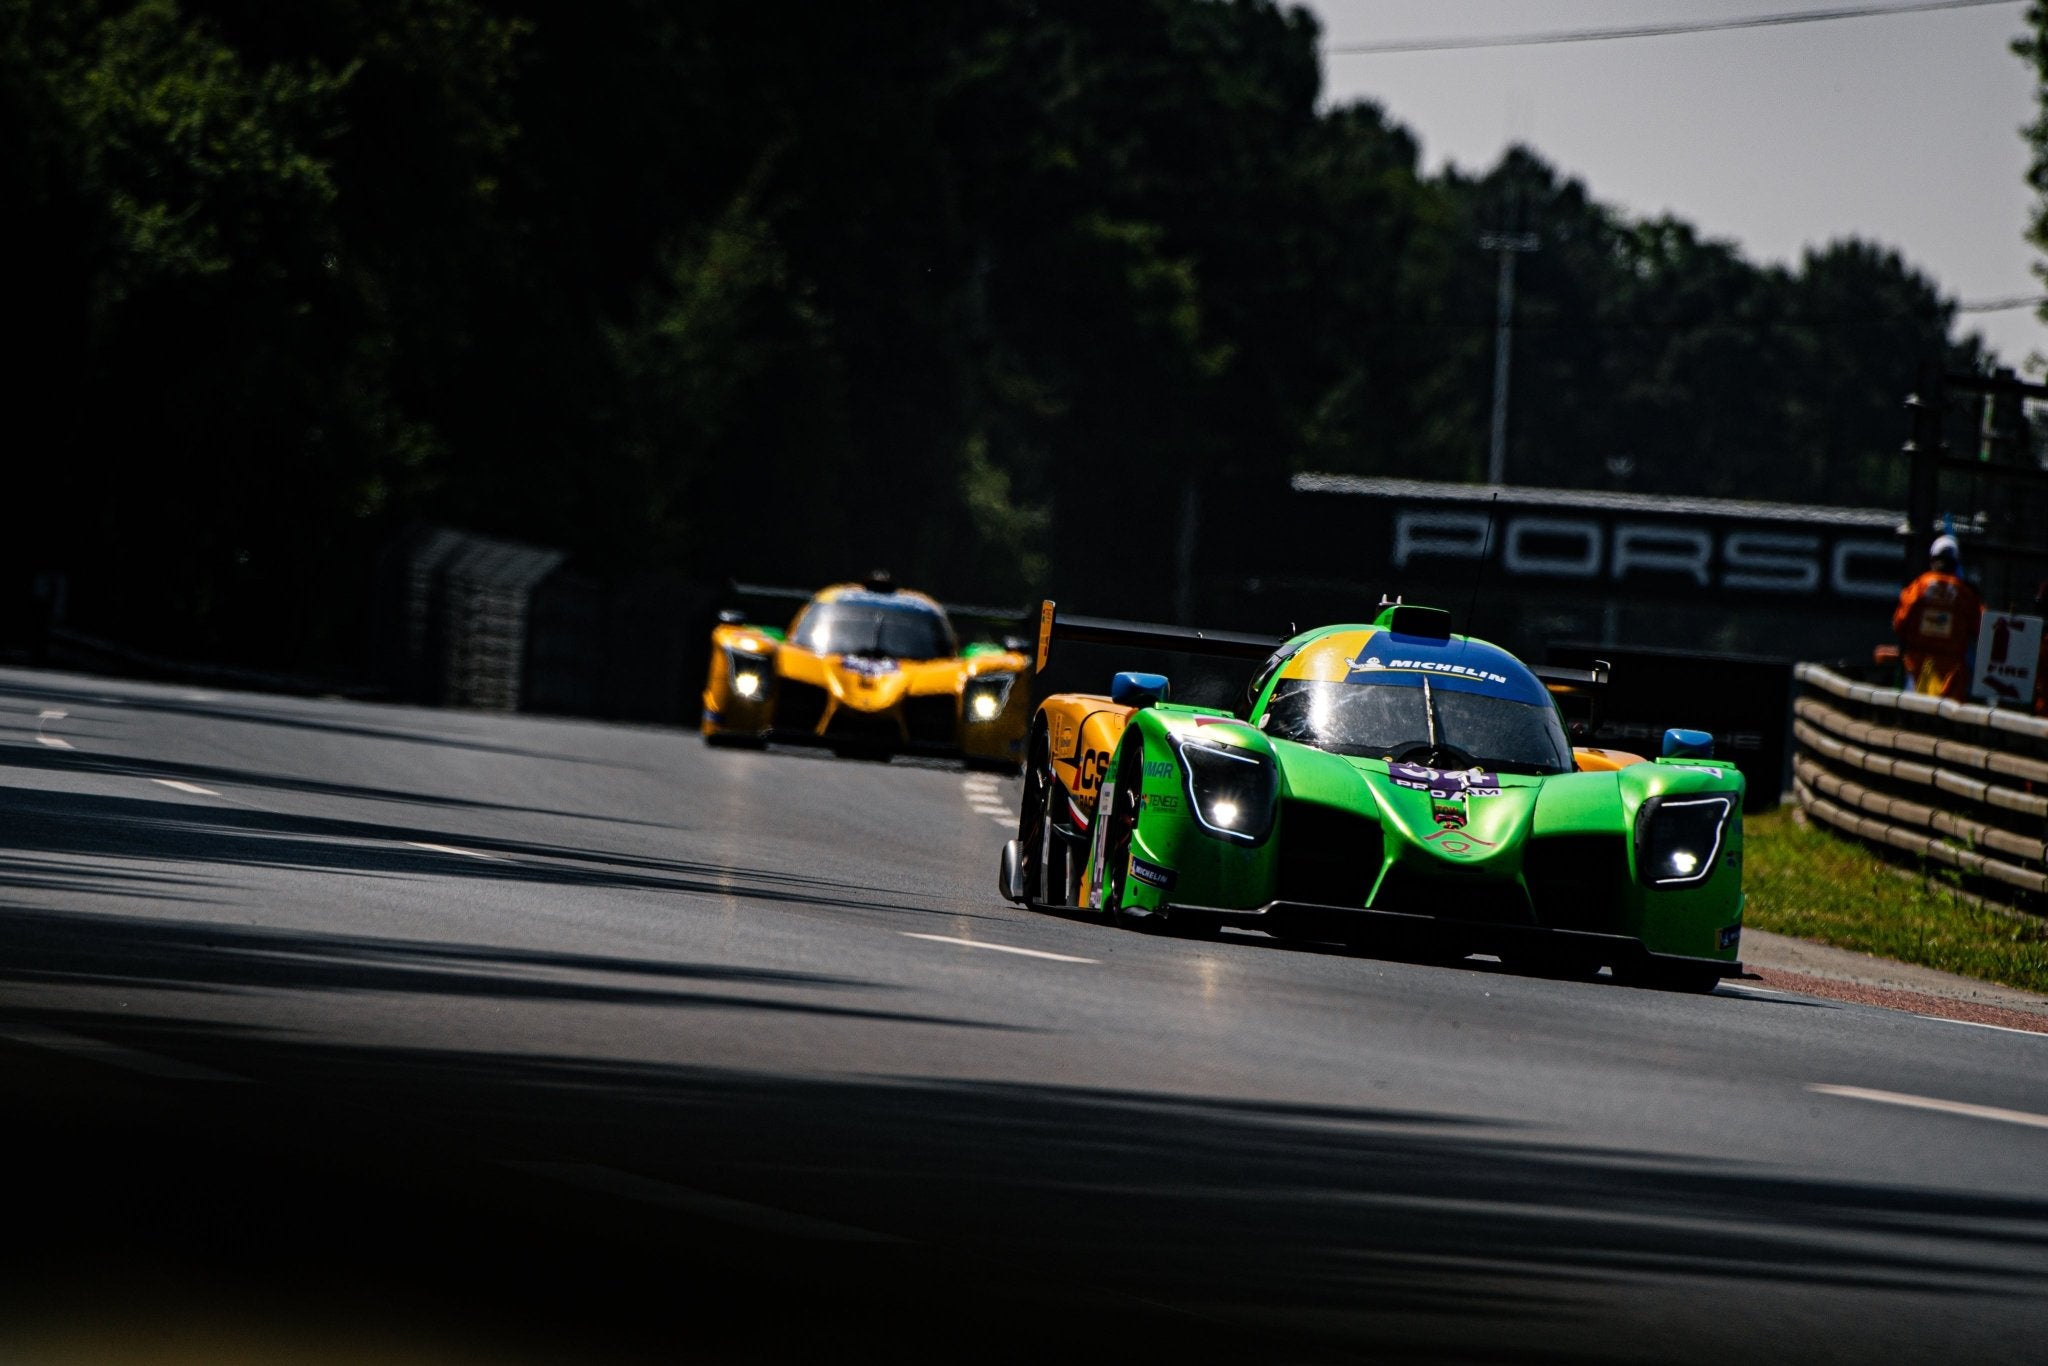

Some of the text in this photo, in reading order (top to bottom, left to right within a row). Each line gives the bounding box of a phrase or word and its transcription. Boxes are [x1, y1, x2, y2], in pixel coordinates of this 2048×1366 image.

[1389, 659, 1508, 684] MICHELIN
[1566, 719, 1763, 749] PORHE
[1136, 864, 1168, 884] MICHELIN
